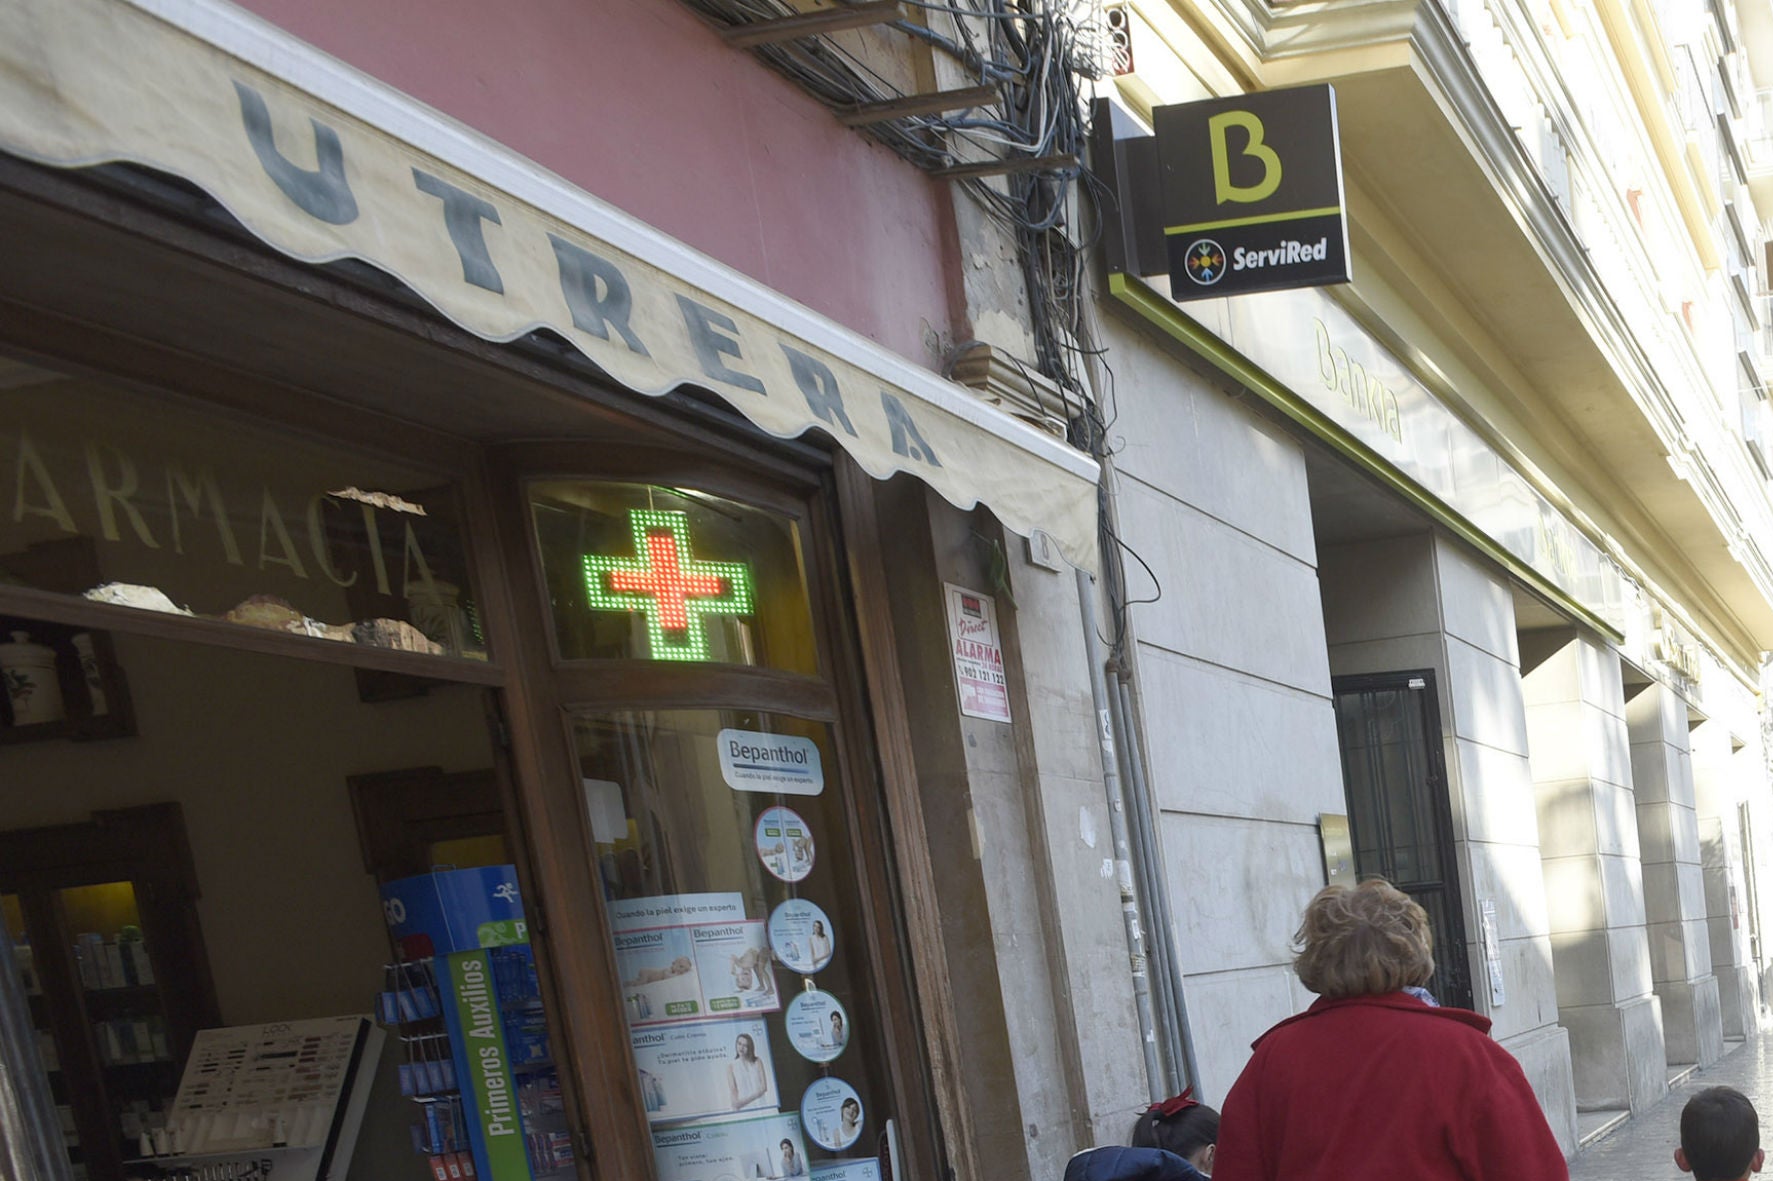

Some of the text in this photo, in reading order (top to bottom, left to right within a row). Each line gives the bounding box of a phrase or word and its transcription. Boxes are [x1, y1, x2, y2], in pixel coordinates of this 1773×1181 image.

[1208, 109, 1283, 206] B
[1233, 237, 1328, 271] ServiRed
[232, 79, 942, 468] UTRERA
[1313, 316, 1403, 445] Bankia
[955, 639, 1002, 665] ALARMA
[964, 666, 977, 679] 902
[979, 669, 990, 682] 121
[729, 740, 807, 764] Bepanthol
[614, 933, 663, 947] Bepanthol
[693, 926, 744, 939] Bepanthol
[460, 959, 514, 1137] Primeros Auxilios
[654, 1131, 702, 1145] Bepanthol
